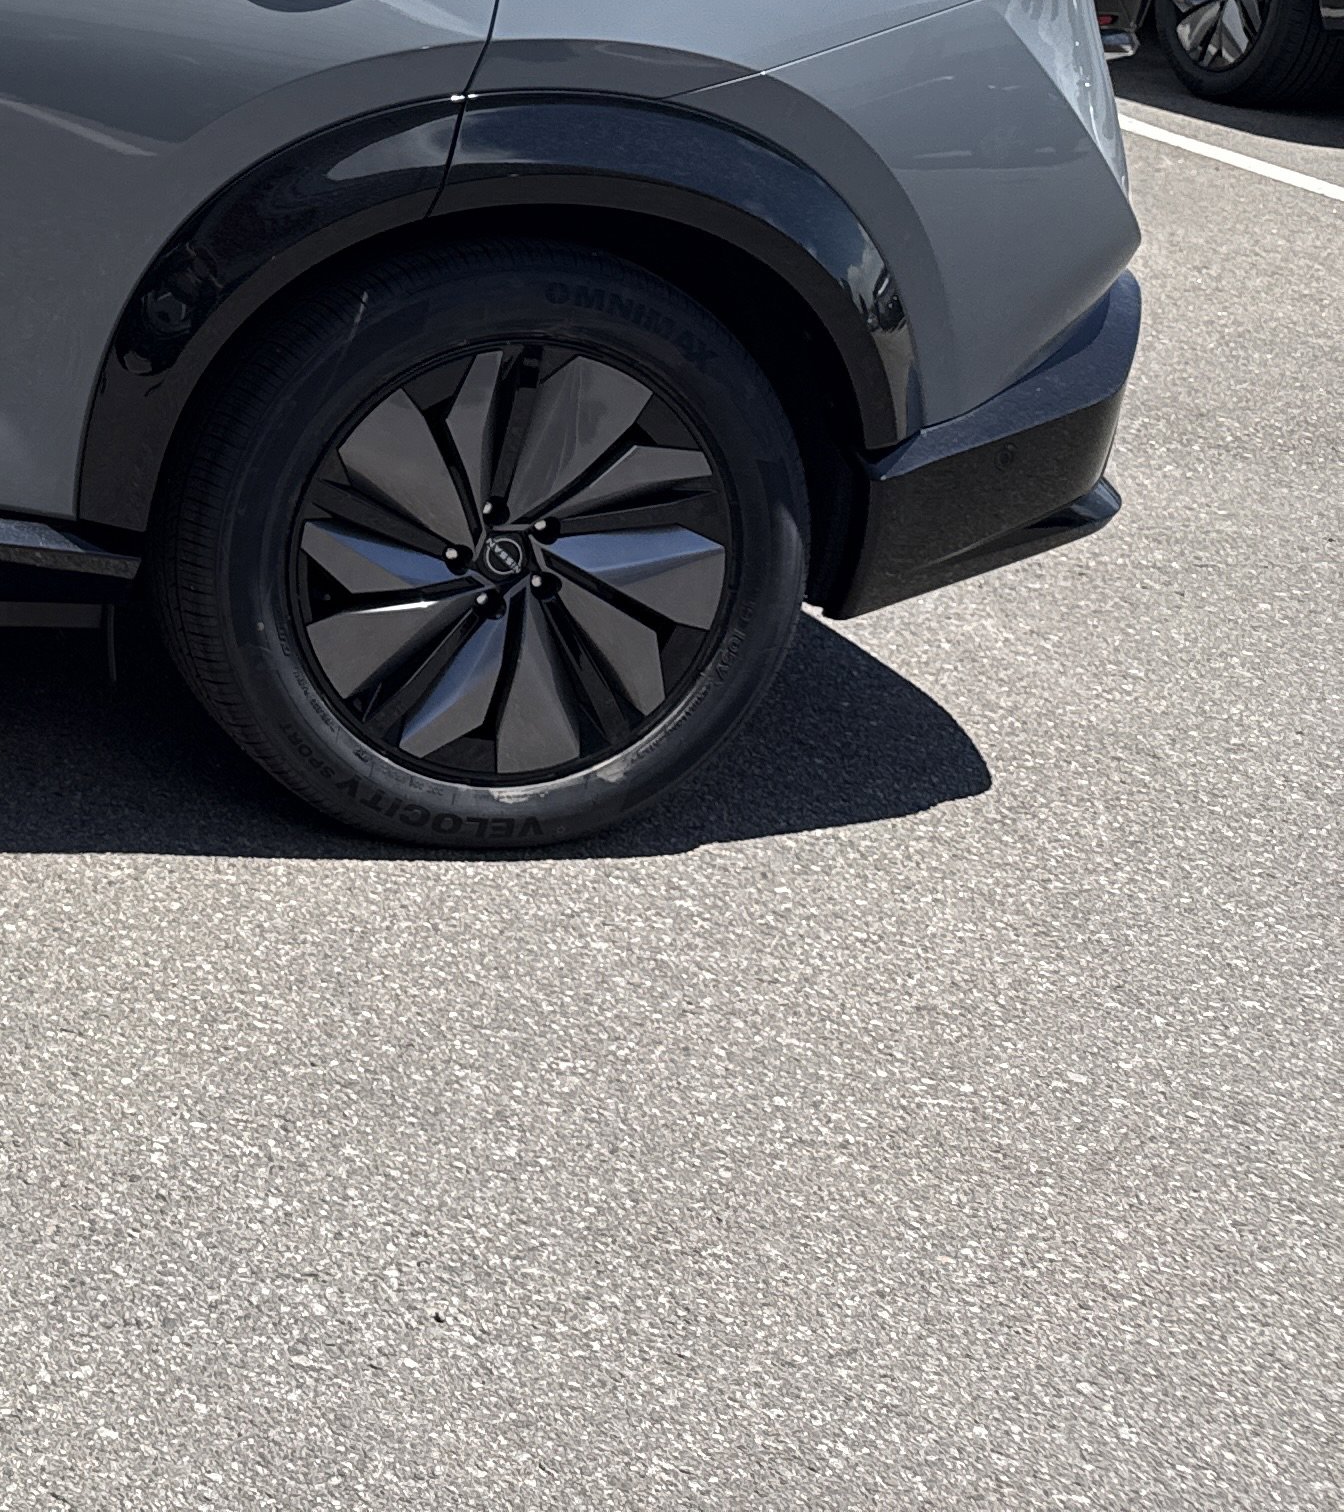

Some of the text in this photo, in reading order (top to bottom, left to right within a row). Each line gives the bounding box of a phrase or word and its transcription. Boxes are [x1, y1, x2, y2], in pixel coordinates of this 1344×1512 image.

[486, 538, 521, 574] NISSAN
[279, 721, 337, 781] SPORT
[335, 774, 545, 839] VELOCITY
